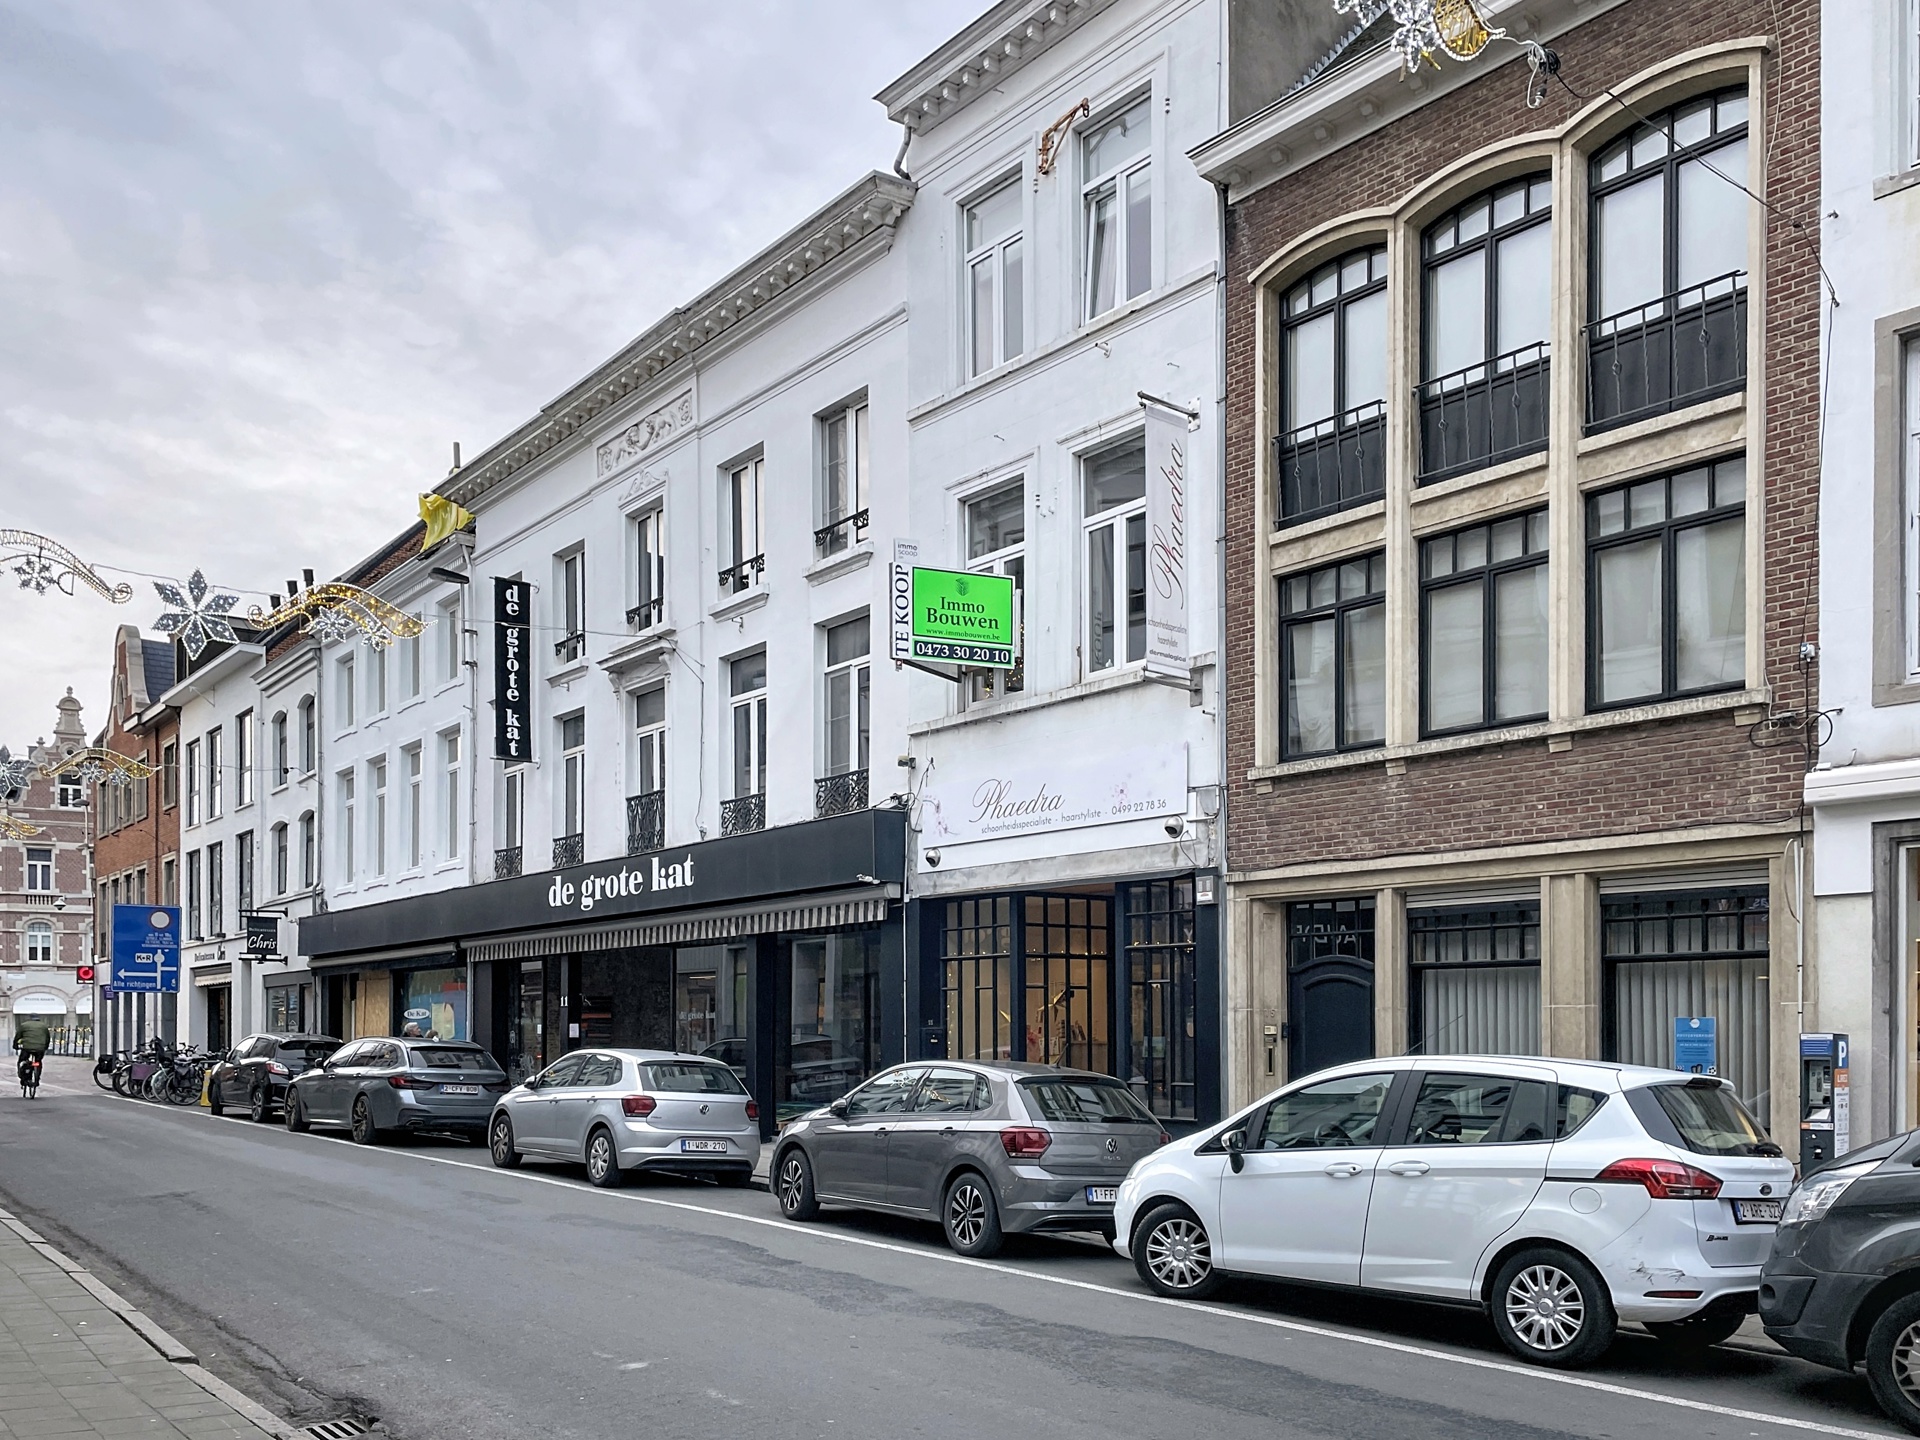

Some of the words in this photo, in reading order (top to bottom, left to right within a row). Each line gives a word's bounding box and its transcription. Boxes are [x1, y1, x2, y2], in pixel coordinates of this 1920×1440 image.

[1150, 438, 1184, 610] Phaedra
[897, 543, 918, 551] immo
[505, 585, 519, 615] de
[895, 564, 909, 625] KOOP
[940, 596, 985, 614] Immo
[926, 607, 999, 630] Bouwen
[895, 631, 909, 656] TE
[926, 628, 1000, 641] www.immobouwen.be
[506, 628, 519, 701] grote
[916, 642, 950, 657] 0473
[952, 646, 970, 659] 30
[973, 648, 990, 661] 20
[993, 650, 1009, 663] 10
[1149, 649, 1187, 662] dermalogica
[506, 708, 520, 756] kat
[969, 778, 1066, 823] Phaedra
[981, 816, 1052, 834] schoonheidsspecialiste
[1061, 808, 1101, 823] haarstyliste
[1111, 804, 1132, 815] 0499
[1134, 803, 1144, 812] 22
[1145, 801, 1155, 810] 78
[1156, 799, 1167, 809] 36
[548, 875, 575, 907] de
[580, 865, 643, 911] grote
[651, 853, 695, 891] kat
[248, 934, 277, 949] Chris
[126, 980, 156, 990] richtingen
[560, 996, 568, 1007] 11
[1838, 1041, 1847, 1066] P
